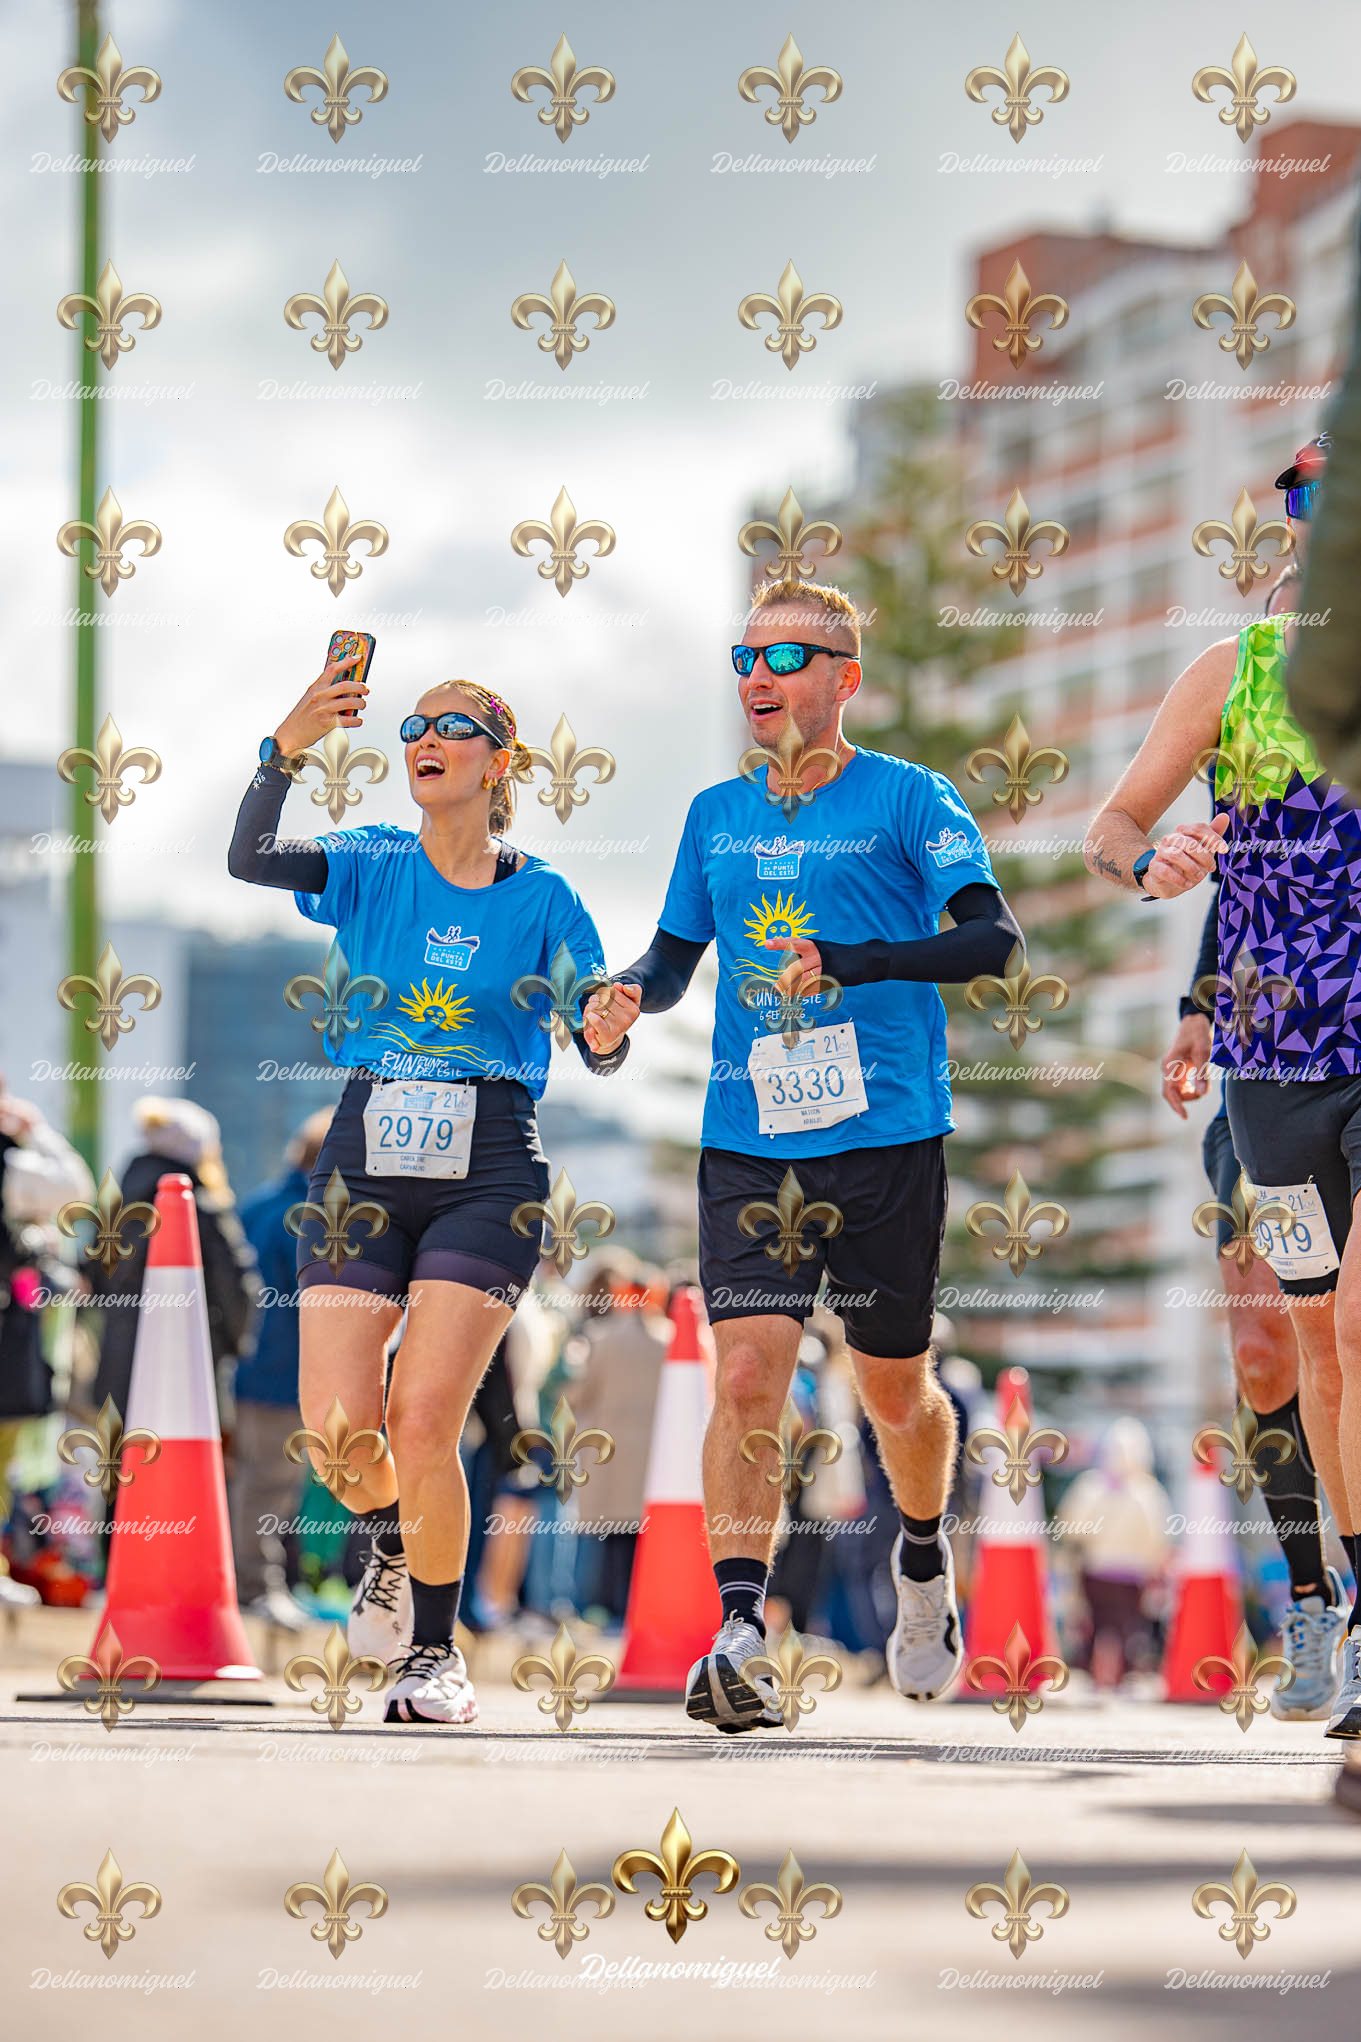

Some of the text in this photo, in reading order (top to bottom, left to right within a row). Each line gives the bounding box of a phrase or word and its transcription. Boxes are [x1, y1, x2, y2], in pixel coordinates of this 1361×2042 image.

[746, 988, 775, 1007] RUN
[760, 1011, 765, 1021] 6
[765, 1010, 780, 1020] SEP
[381, 1050, 449, 1073] RUN PUNTA
[415, 1065, 462, 1077] DEL ESTE
[768, 1065, 844, 1105] 3330
[378, 1115, 453, 1151] 2979
